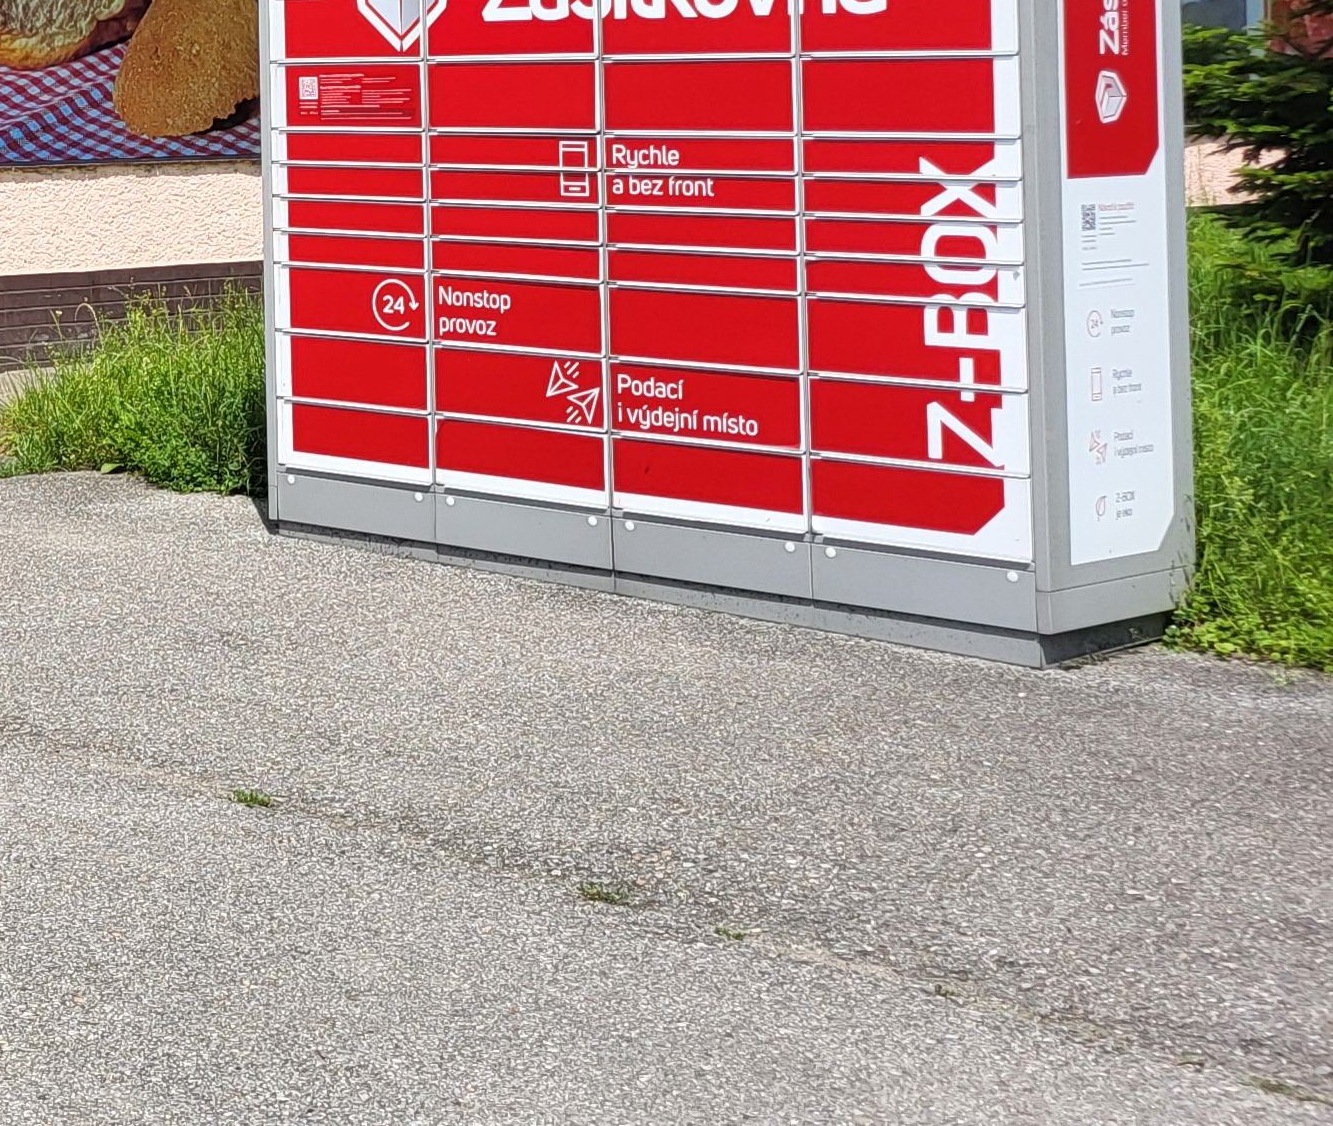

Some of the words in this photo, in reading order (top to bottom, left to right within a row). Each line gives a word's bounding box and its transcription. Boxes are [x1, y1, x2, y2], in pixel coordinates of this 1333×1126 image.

[1121, 12, 1129, 56] Member
[612, 144, 680, 169] Rychle
[613, 178, 624, 195] a
[629, 175, 664, 195] bez
[669, 176, 715, 197] front
[383, 295, 405, 315] 24
[438, 285, 511, 314] Nonstop
[919, 156, 1005, 469] Z-BOX
[439, 316, 497, 336] provoz
[617, 374, 684, 400] Podací
[617, 402, 623, 422] i
[627, 405, 699, 432] výdejní
[703, 412, 758, 436] místo
